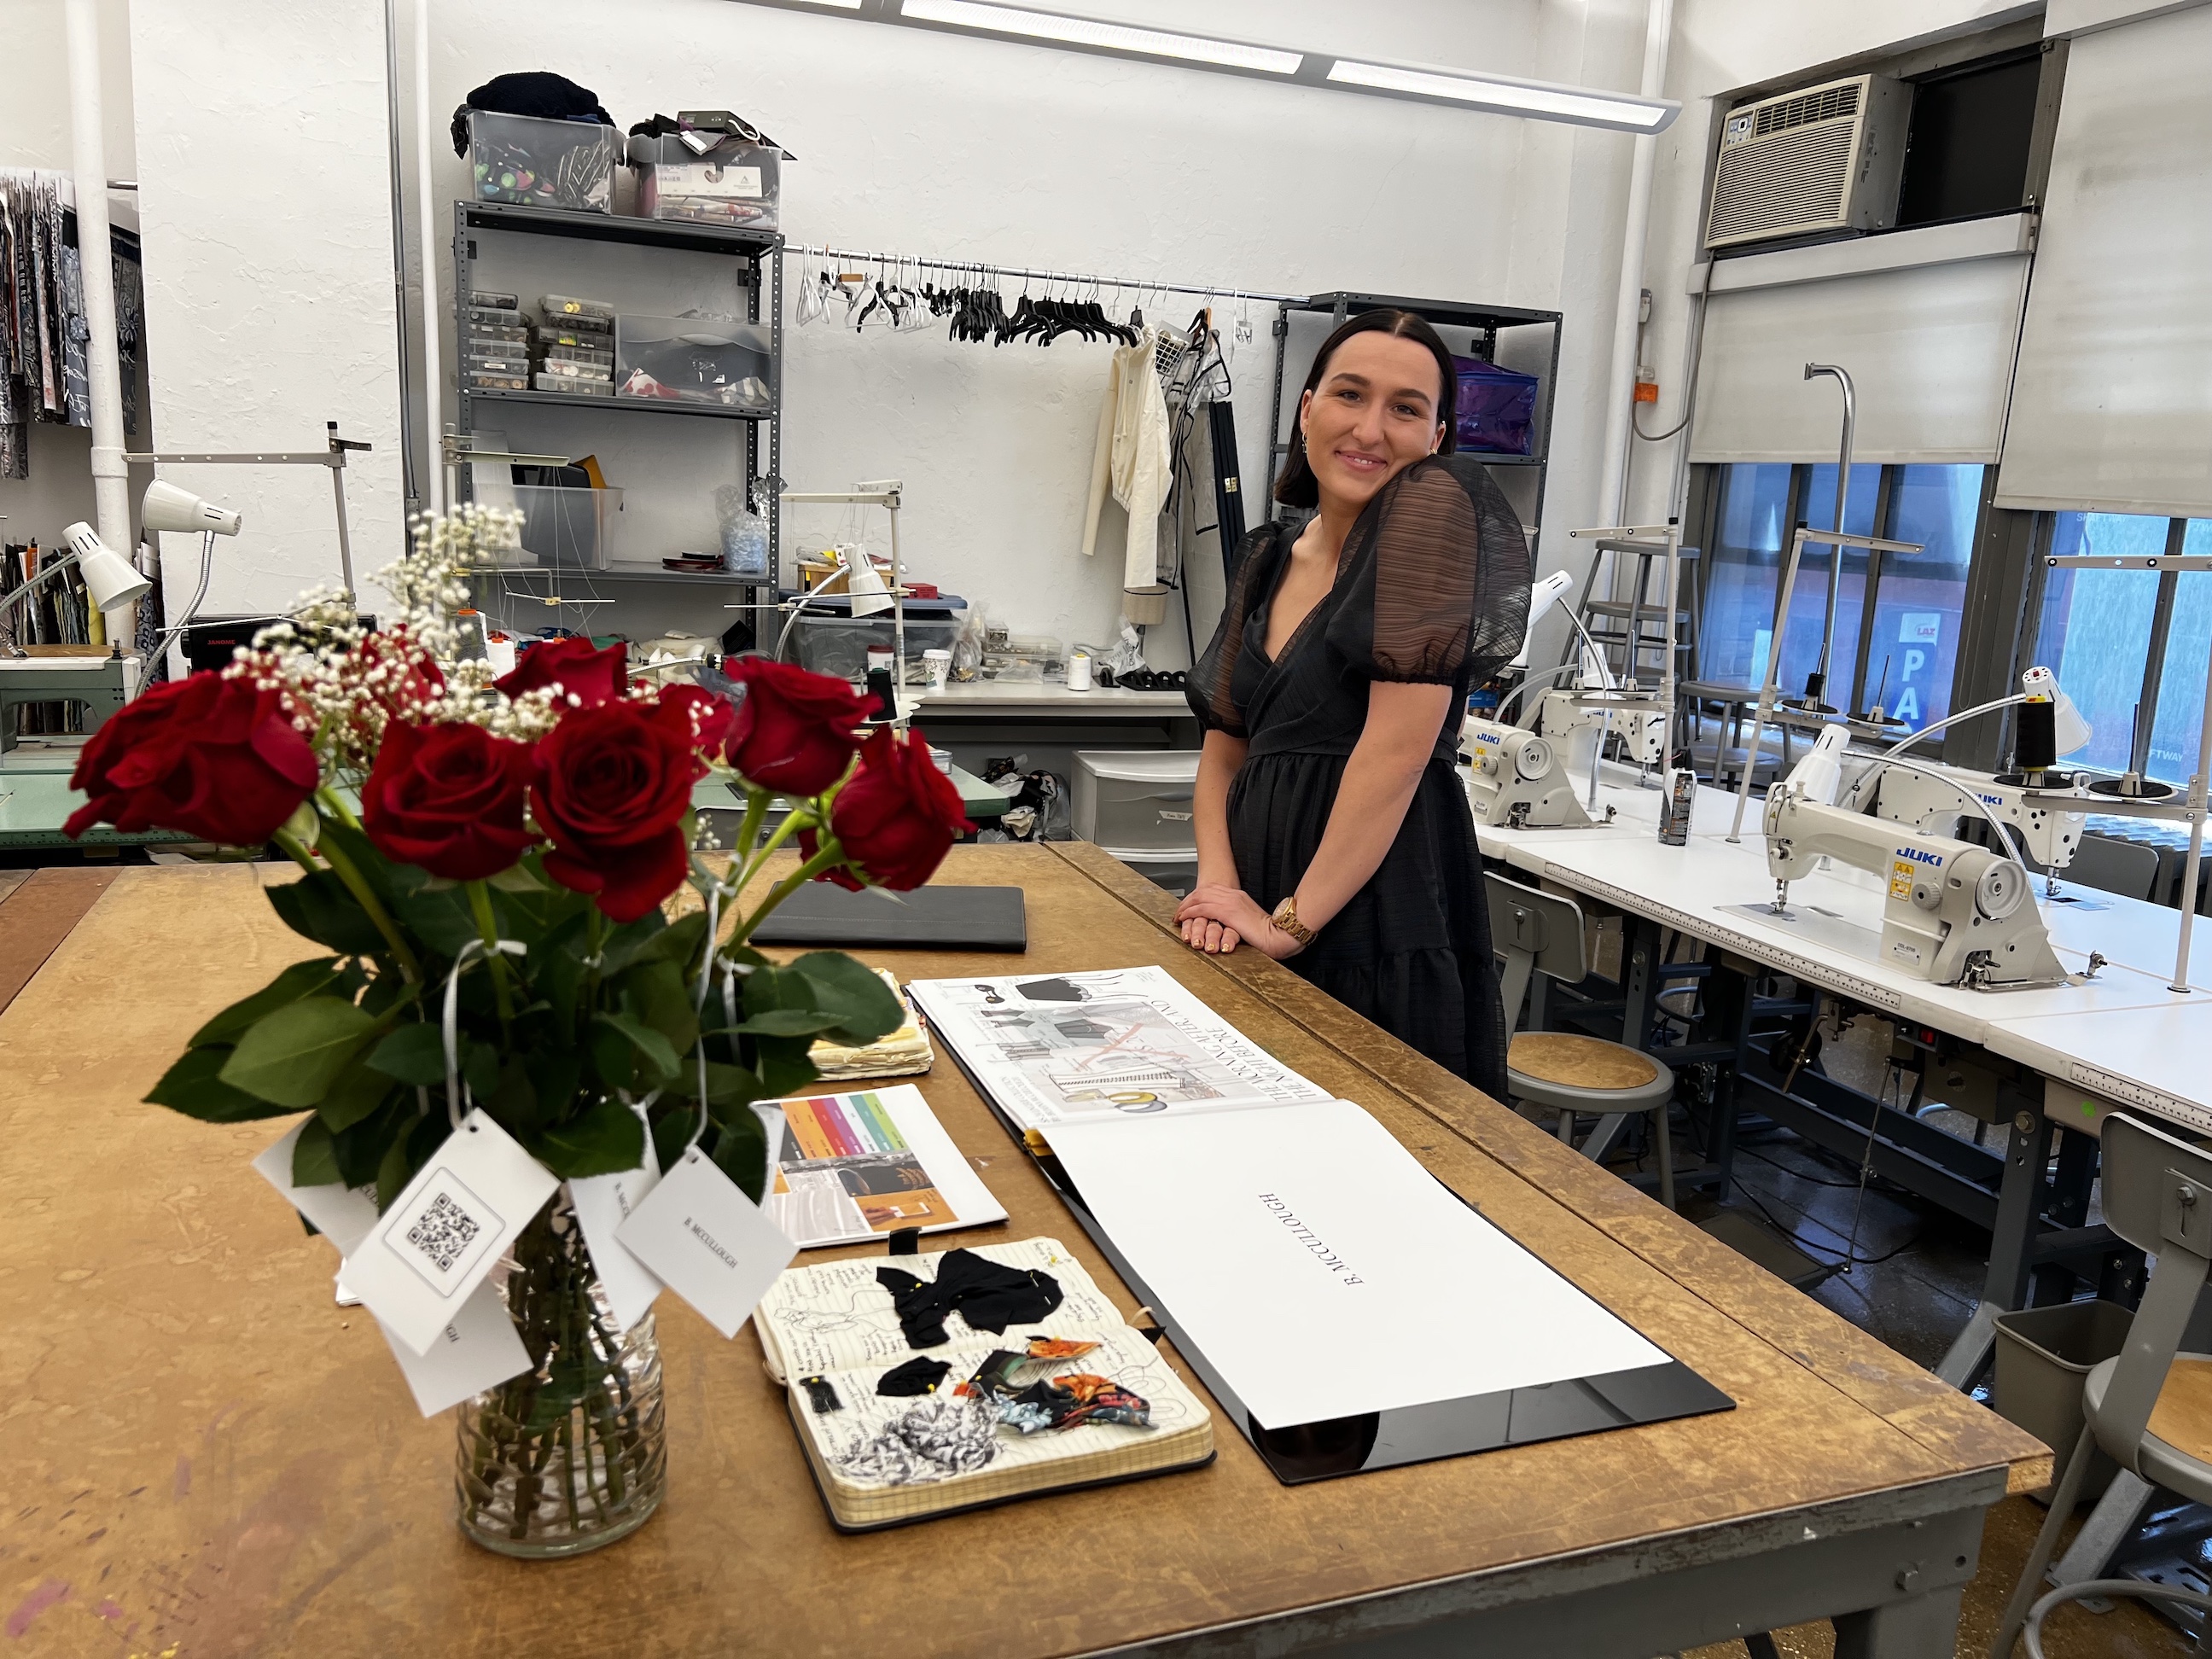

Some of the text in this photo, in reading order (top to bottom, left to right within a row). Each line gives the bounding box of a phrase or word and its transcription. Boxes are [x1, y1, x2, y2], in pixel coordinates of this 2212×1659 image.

[1477, 733, 1499, 745] JUKI
[1896, 847, 1942, 867] JUKI
[1151, 1000, 1179, 1016] AND
[1203, 1045, 1264, 1085] MORNING
[1205, 1026, 1317, 1099] THE NIGHT BEFORE
[1258, 1085, 1293, 1102] THE
[684, 1216, 739, 1269] B. MCCULLOUGH
[1257, 1193, 1365, 1286] B. MCCULLOUGH
